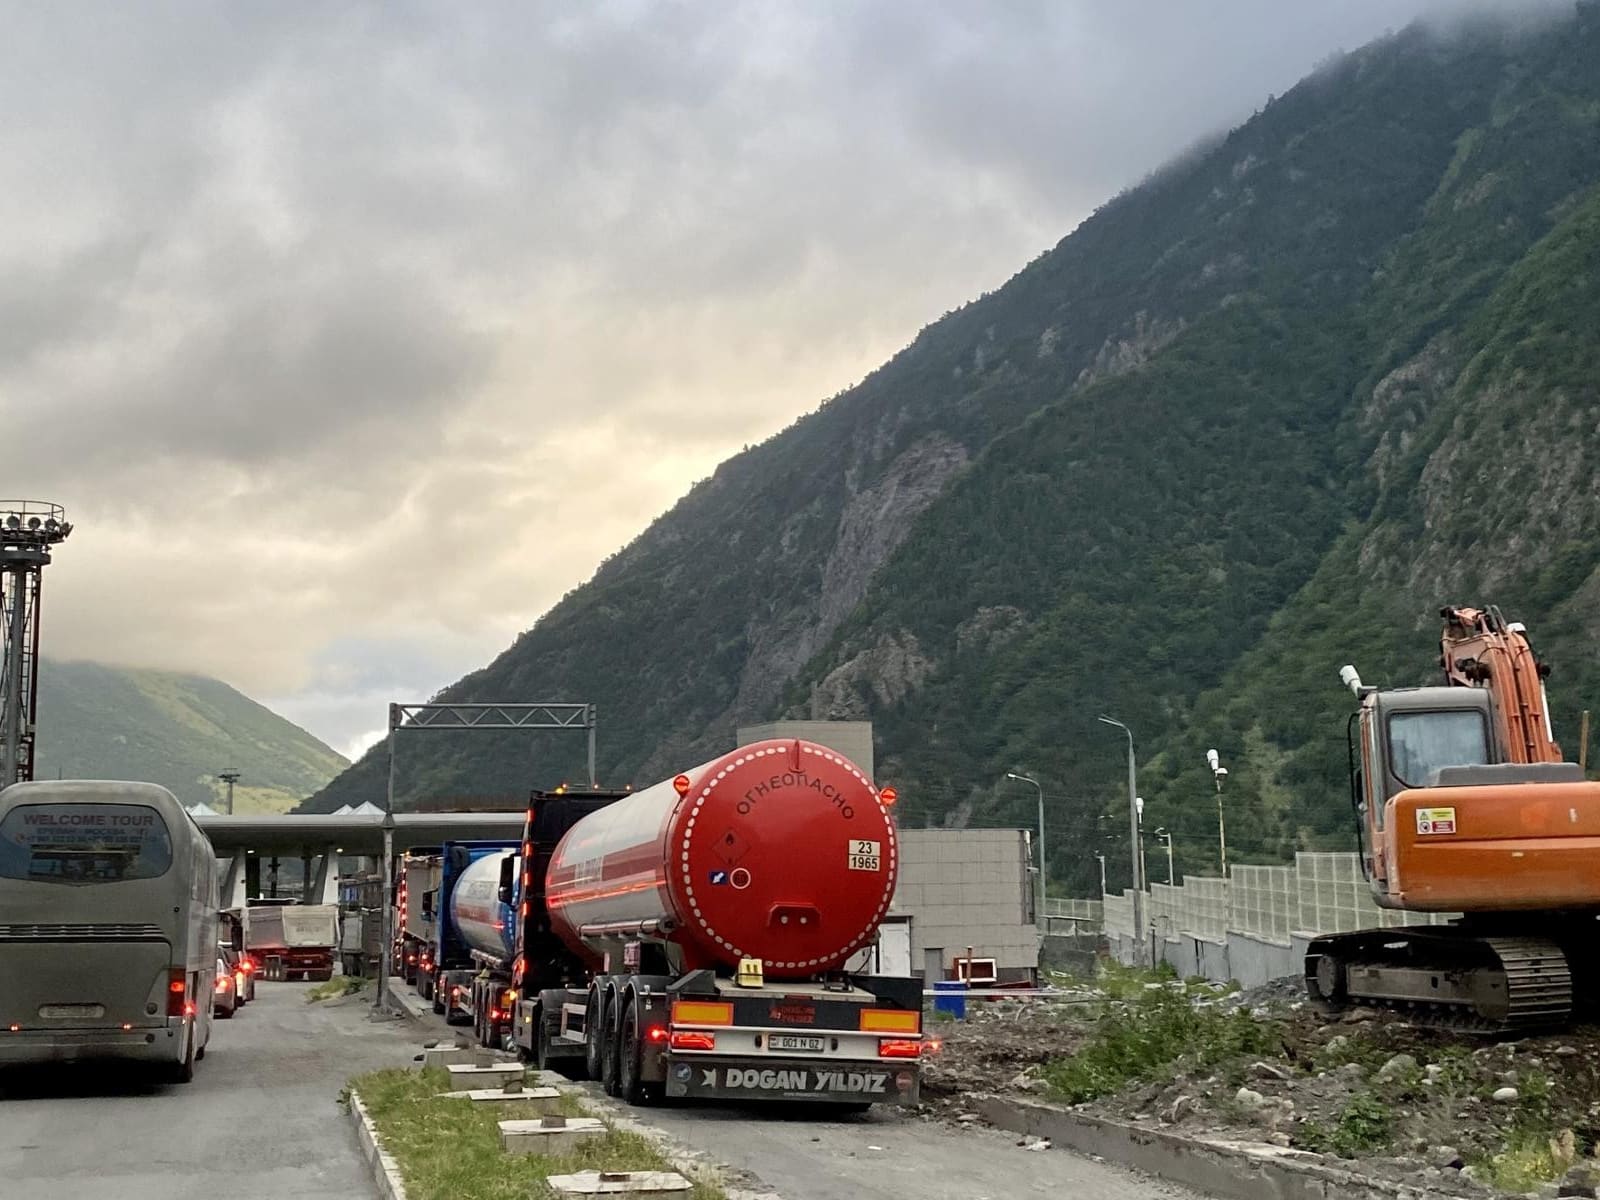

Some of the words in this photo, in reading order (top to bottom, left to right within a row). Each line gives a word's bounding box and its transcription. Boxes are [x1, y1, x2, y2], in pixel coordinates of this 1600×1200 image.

[737, 773, 854, 819] ОГНЕОПАСНО
[24, 814, 105, 825] WELCOME
[111, 815, 153, 826] TOUR
[858, 841, 872, 854] 23
[851, 856, 878, 869] 1965
[726, 1068, 807, 1090] DOGAN
[814, 1070, 889, 1093] YILDIZ
